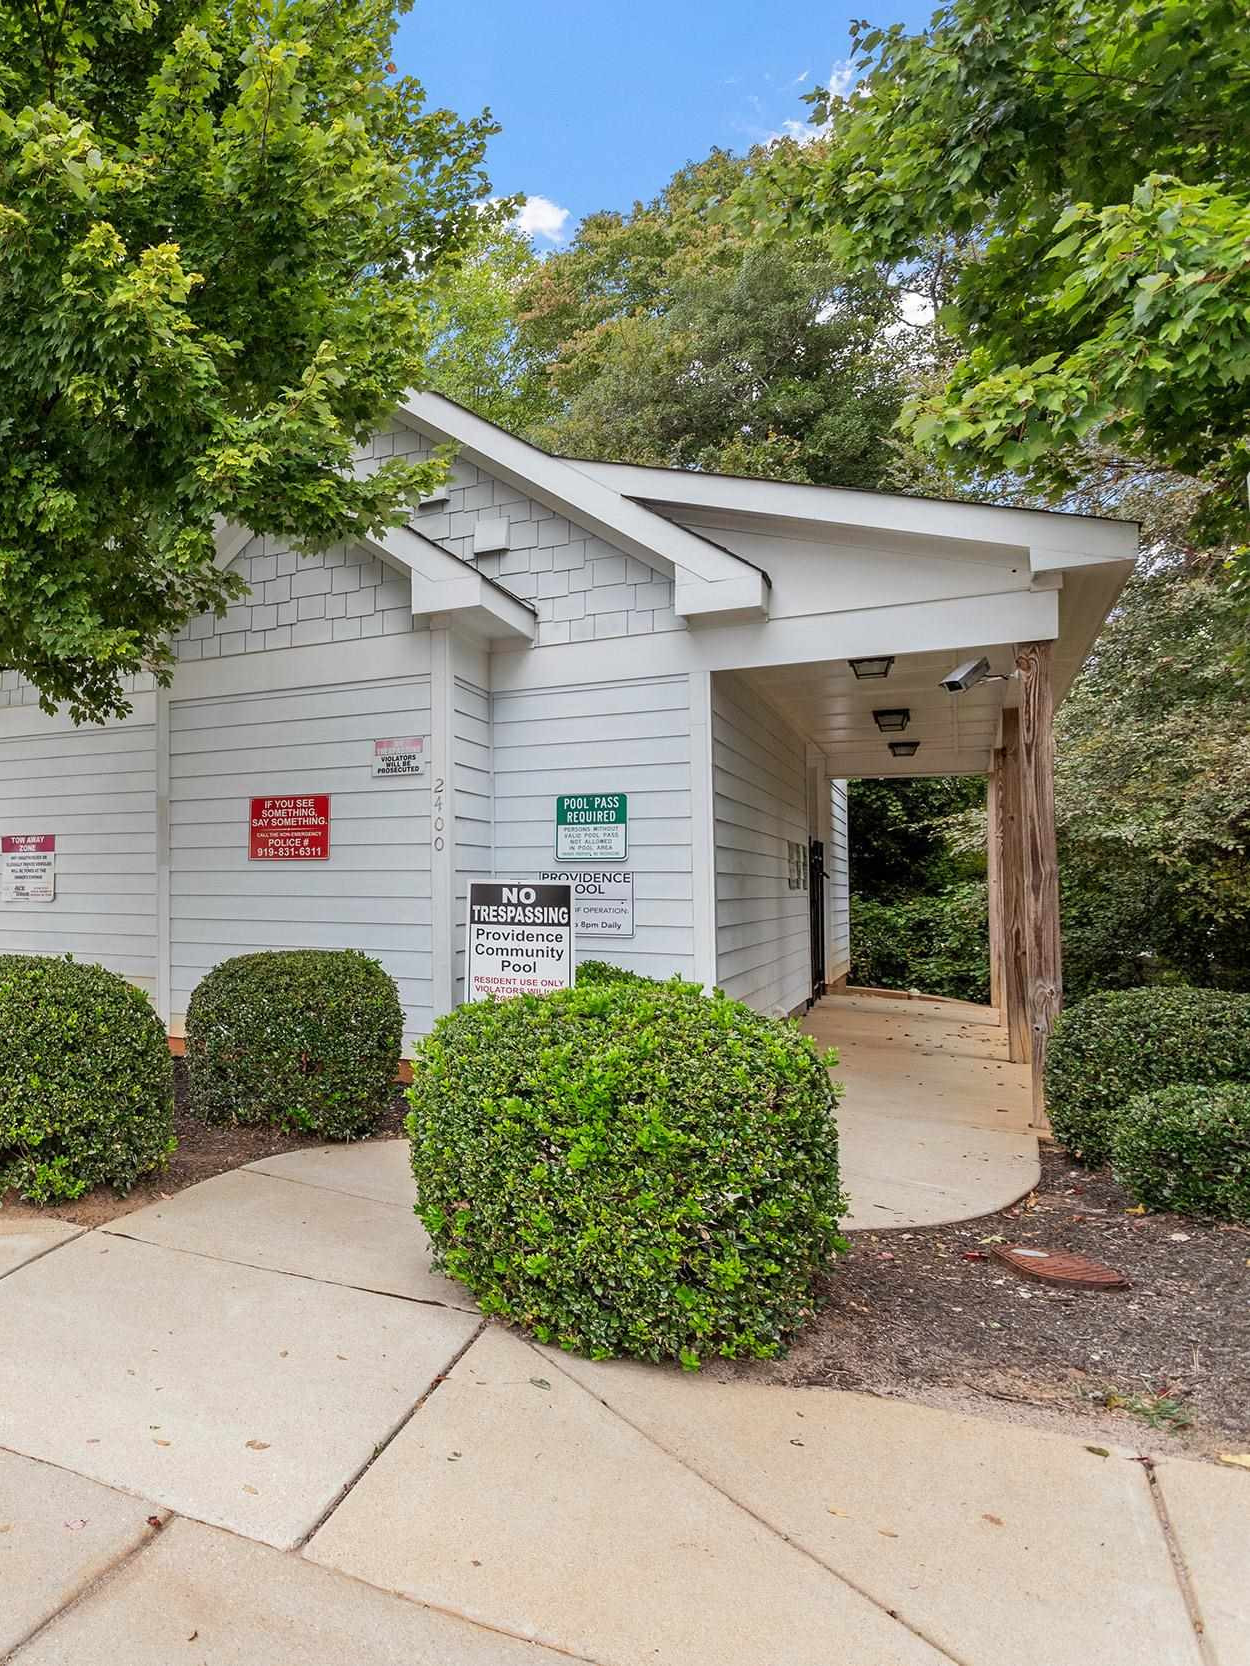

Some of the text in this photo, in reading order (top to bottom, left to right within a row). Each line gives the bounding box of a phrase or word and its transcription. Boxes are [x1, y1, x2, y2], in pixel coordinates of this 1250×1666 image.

[377, 766, 420, 774] PROSECUTED
[264, 799, 314, 809] IF YOU SEE
[564, 797, 619, 809] POOL PASS
[262, 808, 318, 817] SOMETHING,
[434, 778, 444, 852] 2400
[567, 810, 616, 823] REQUIRED
[252, 817, 328, 827] SAY SOMETHING.
[268, 838, 310, 847] POLICE #
[257, 847, 321, 857] 919-831-6311
[542, 873, 630, 883] PROVIDENCE
[574, 884, 605, 894] OOL
[501, 887, 536, 904] NO
[472, 905, 569, 924] TRESPASSING
[581, 921, 599, 929] 8pm
[601, 921, 622, 930] Daily
[476, 928, 564, 943] Providence
[475, 943, 564, 961] Community
[501, 960, 537, 974] Pool
[474, 976, 564, 987] RESIDENT USE ONLY
[475, 985, 525, 994] VIOLATORS
